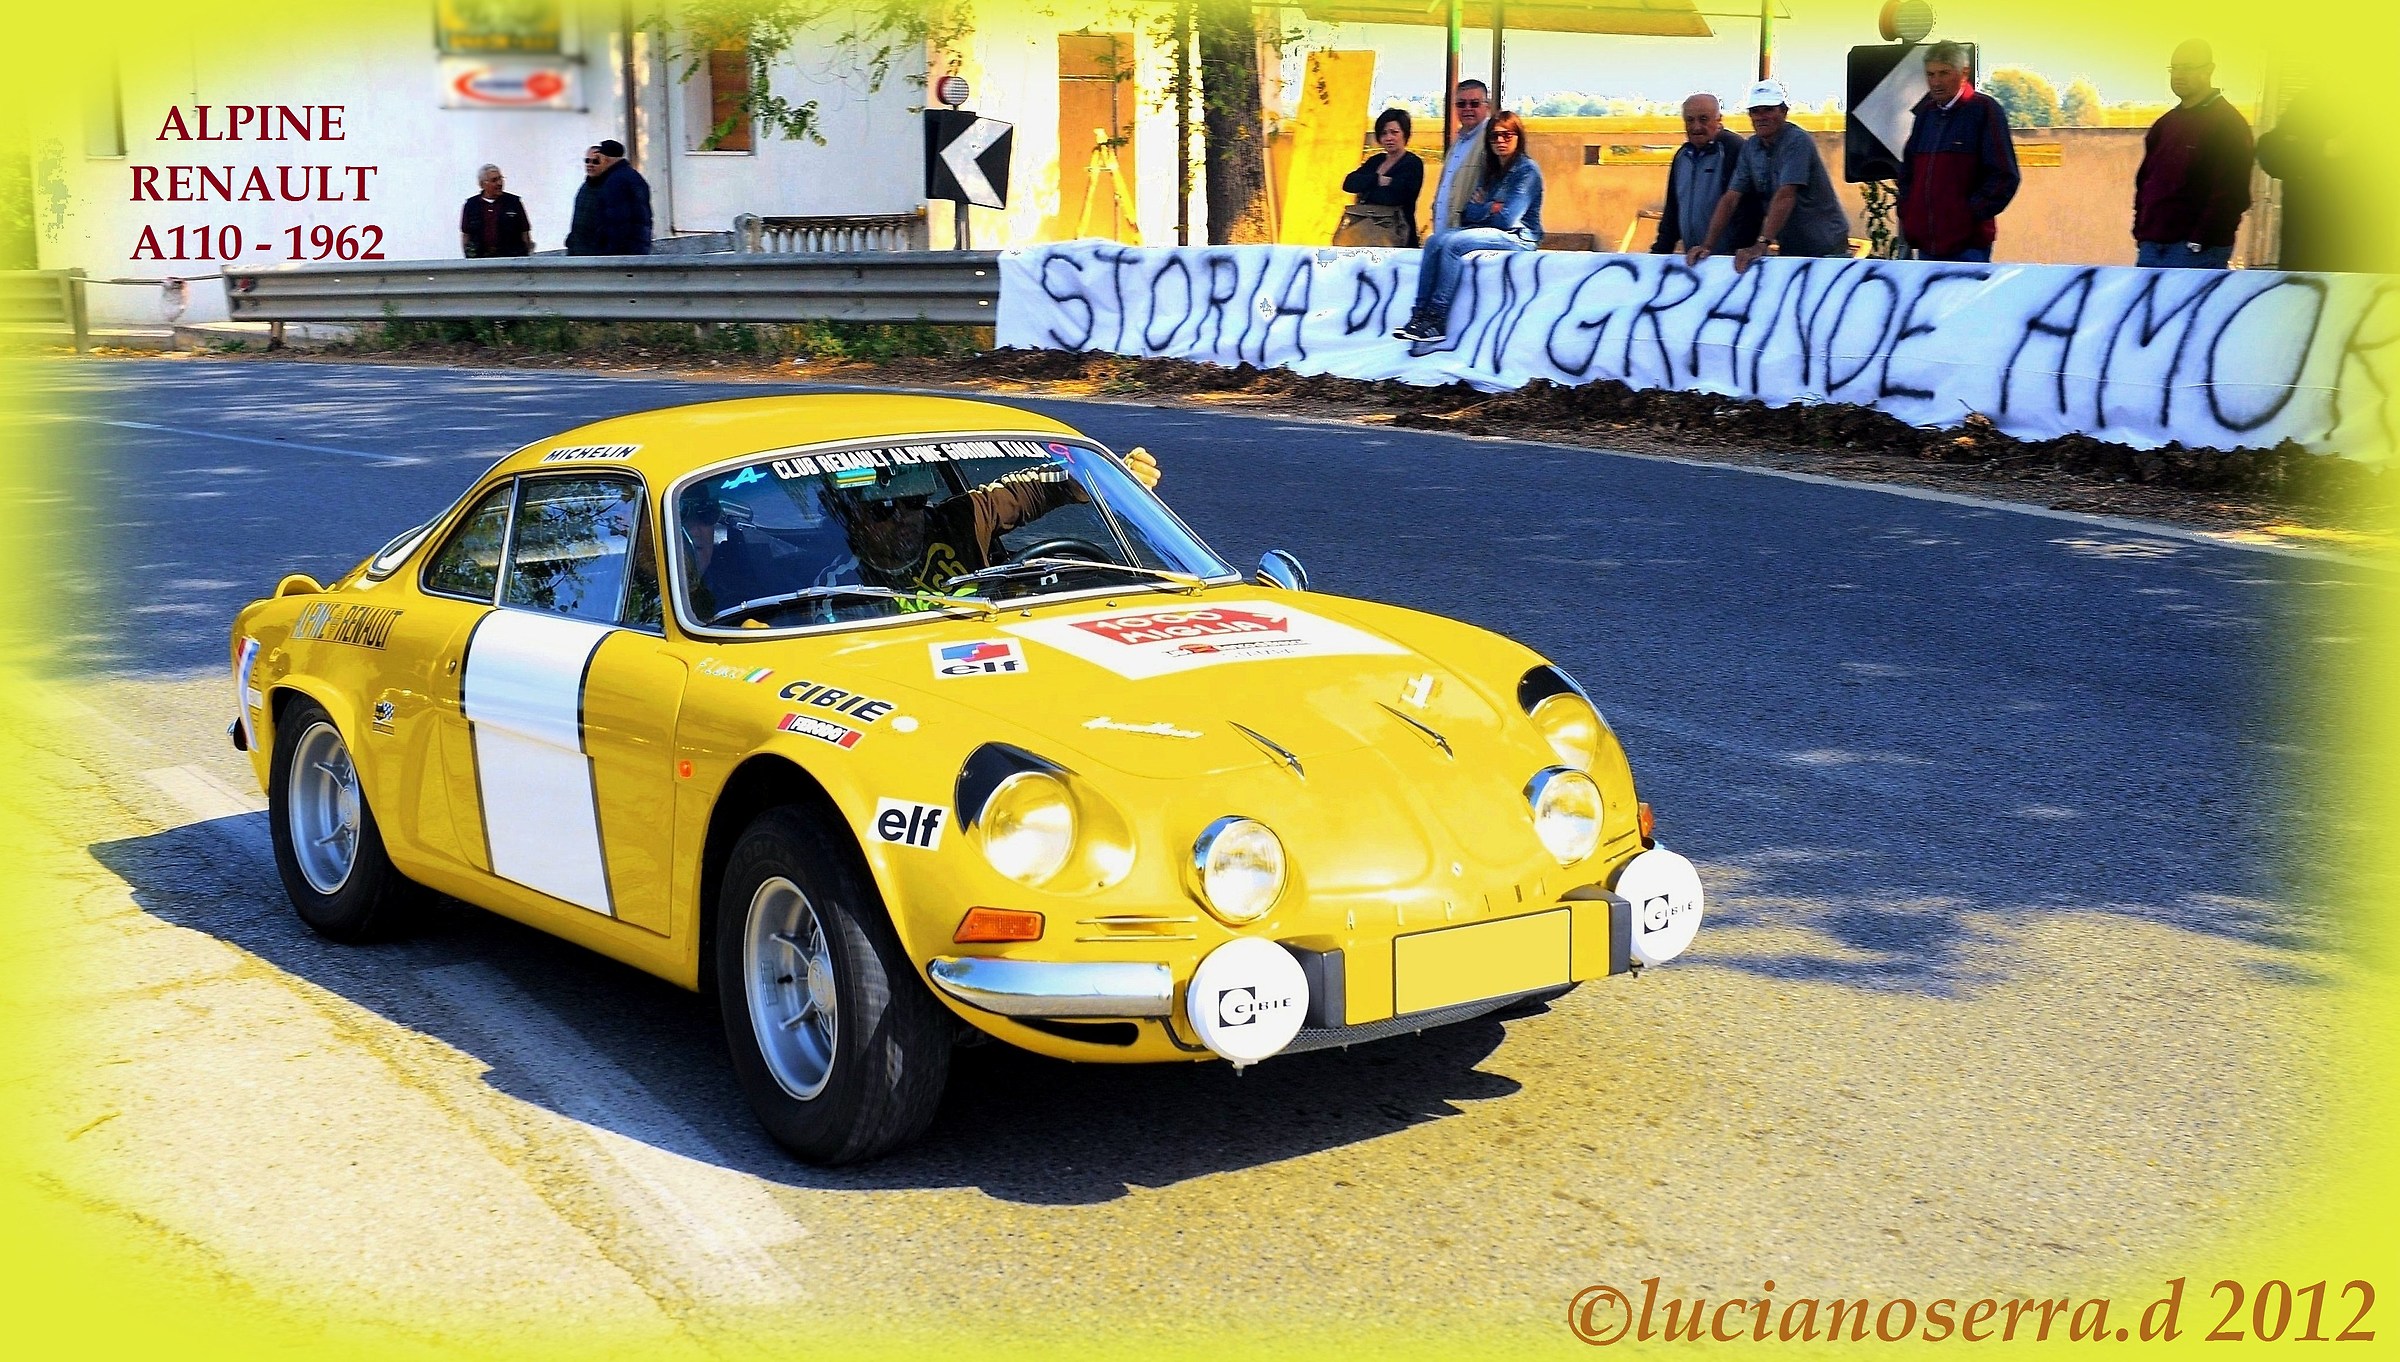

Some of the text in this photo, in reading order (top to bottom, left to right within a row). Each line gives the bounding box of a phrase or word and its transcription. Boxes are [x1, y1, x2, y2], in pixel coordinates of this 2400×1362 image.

[1043, 250, 1312, 362] STORIA
[1344, 264, 1399, 338] DI
[1546, 256, 1991, 401] GRANDE
[543, 446, 637, 462] MICHELIN
[772, 440, 1052, 480] CLUB RENAULT ALPINE GORDINI ITALIA
[291, 601, 405, 648] ALPINE RENAULT
[1096, 610, 1224, 631] 1000
[1119, 620, 1269, 644] MIGLIA
[941, 659, 1020, 675] elf
[779, 681, 894, 722] CIBIE
[878, 805, 942, 847] elf
[1653, 901, 1693, 920] CIBIE
[1234, 997, 1292, 1013] CIBIE
